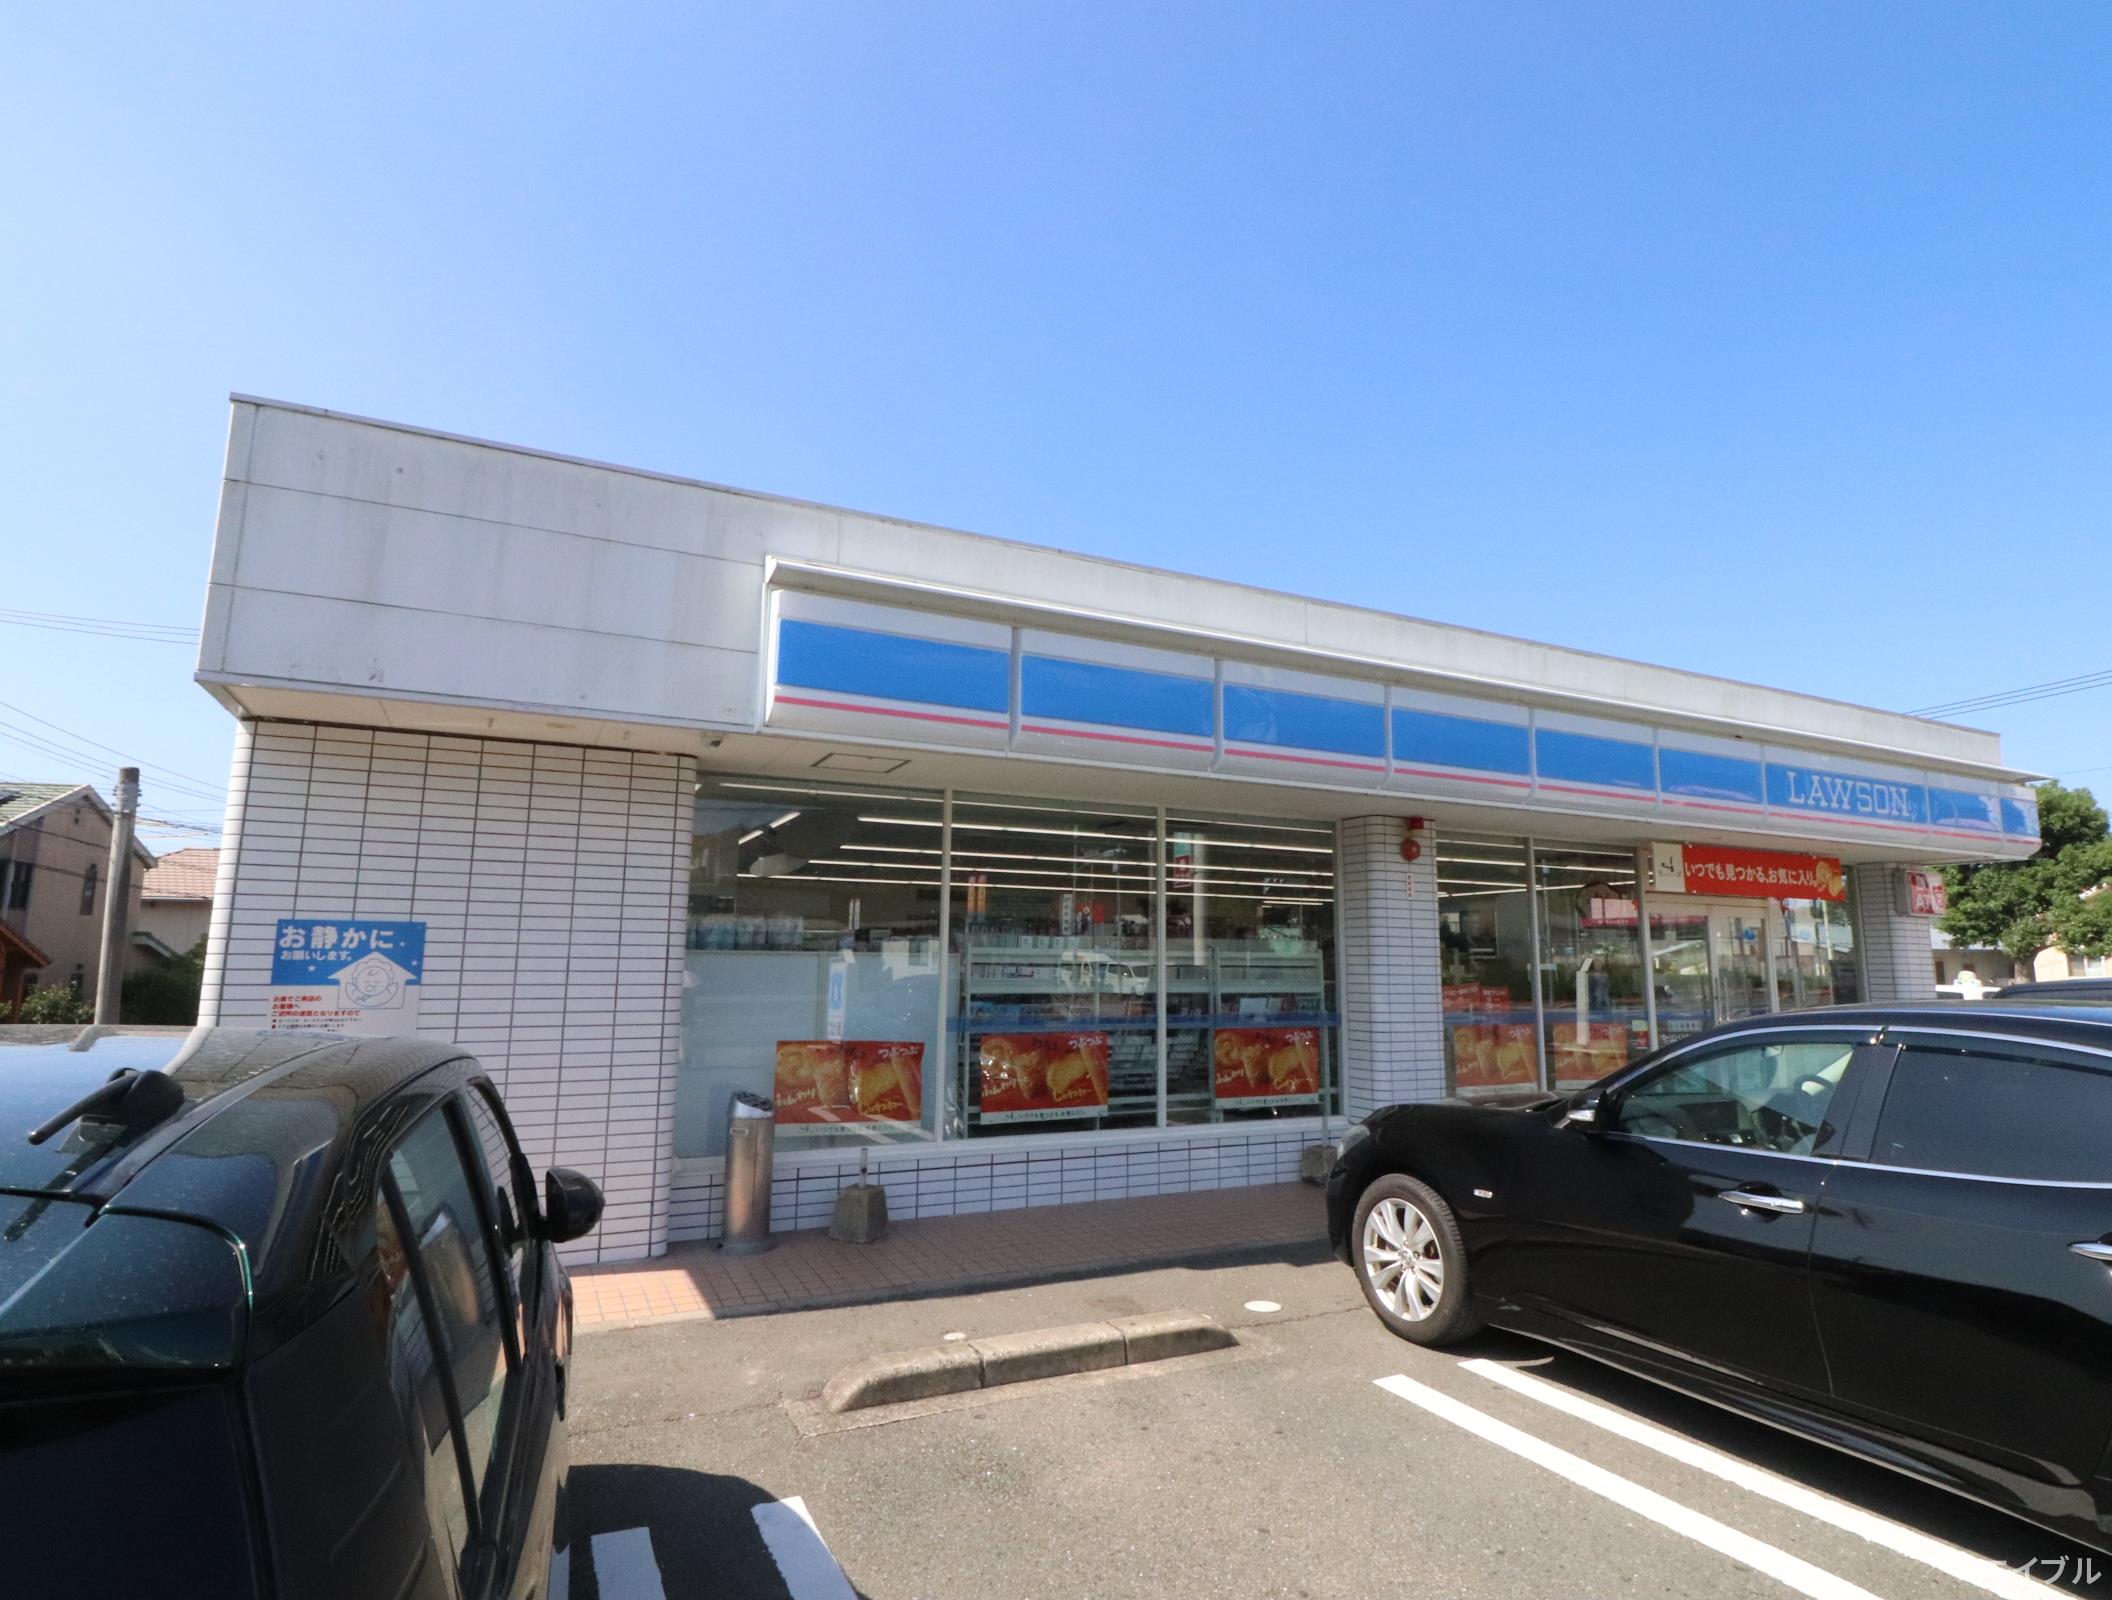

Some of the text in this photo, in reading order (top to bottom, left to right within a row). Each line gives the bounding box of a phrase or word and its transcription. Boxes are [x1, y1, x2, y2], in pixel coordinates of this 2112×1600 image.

[1787, 771, 1910, 817] LAWSON
[1684, 861, 1818, 888] いつでも見つかる、お気に入り。
[279, 925, 394, 949] お静かに
[281, 950, 352, 961] お願いします。
[1068, 1035, 1103, 1049] つぶつぶ
[878, 1046, 920, 1058] つぶつぶ
